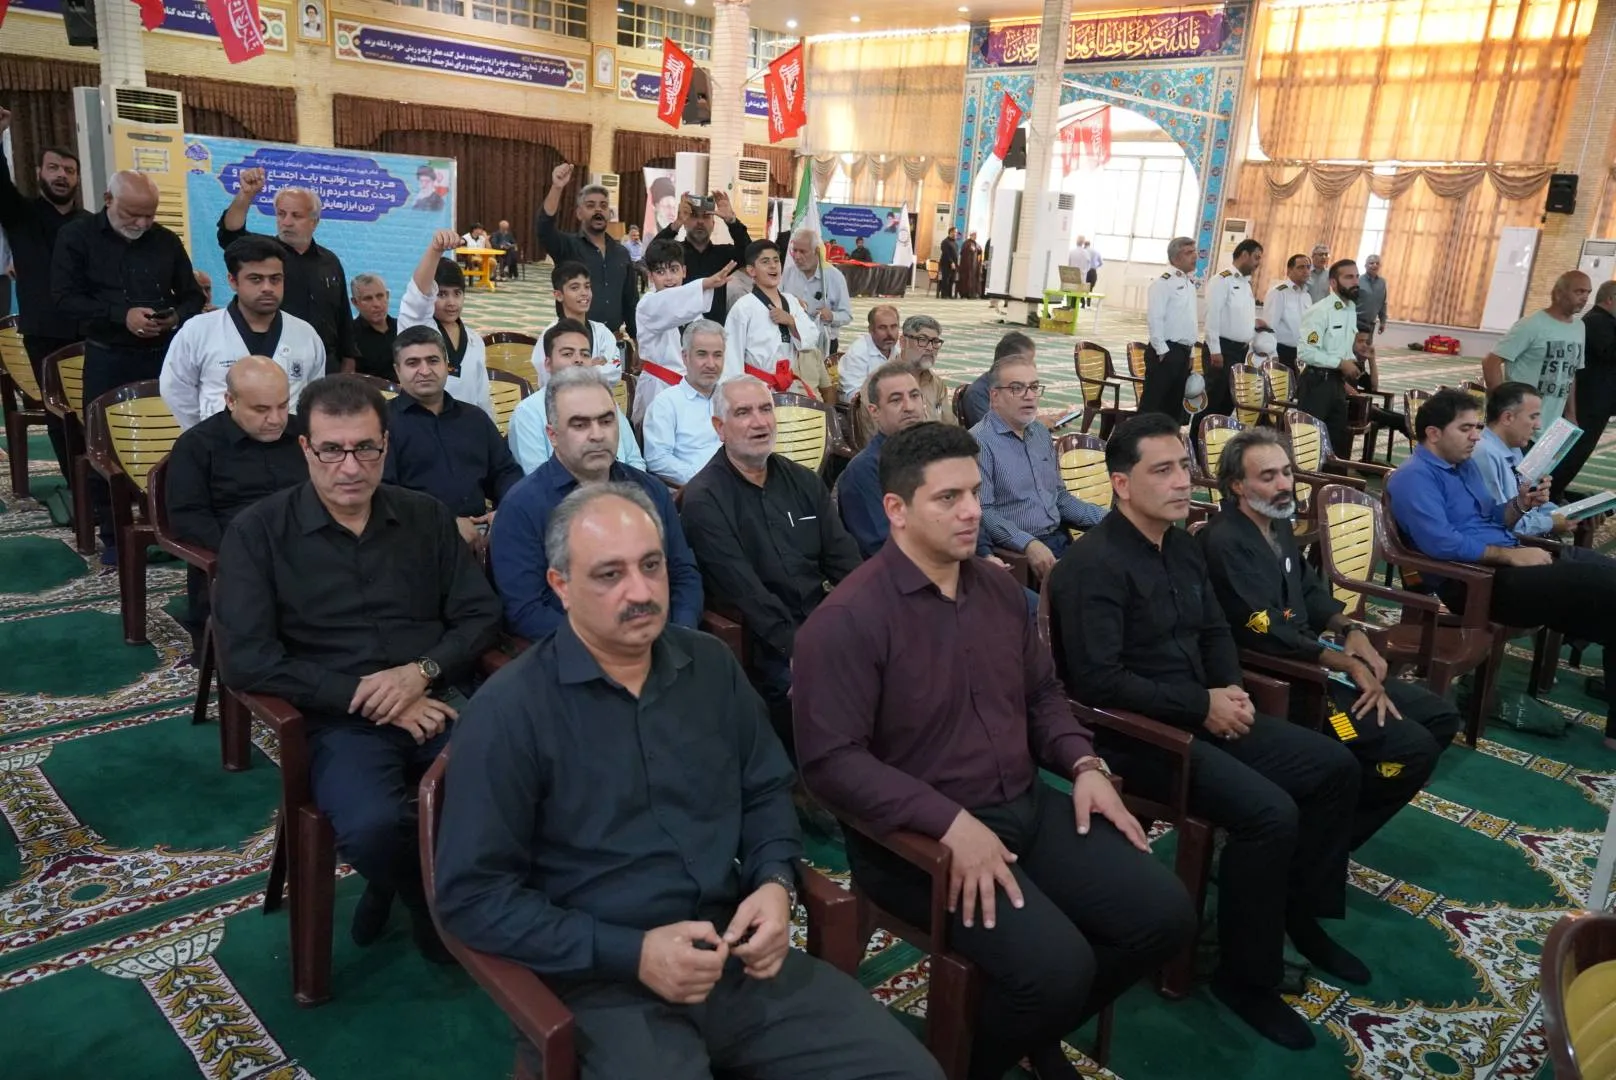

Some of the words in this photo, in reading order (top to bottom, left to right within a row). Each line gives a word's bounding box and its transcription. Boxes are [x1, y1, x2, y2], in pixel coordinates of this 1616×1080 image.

[267, 169, 298, 182] اجتماع
[300, 171, 318, 183] باید
[320, 173, 347, 186] توانیم
[349, 178, 365, 187] می
[366, 178, 380, 190] چه
[380, 180, 396, 189] هر
[319, 186, 326, 197] را
[327, 188, 348, 198] مردم
[350, 188, 370, 198] کلمه
[371, 190, 396, 202] وحدت
[358, 202, 375, 212] ترین
